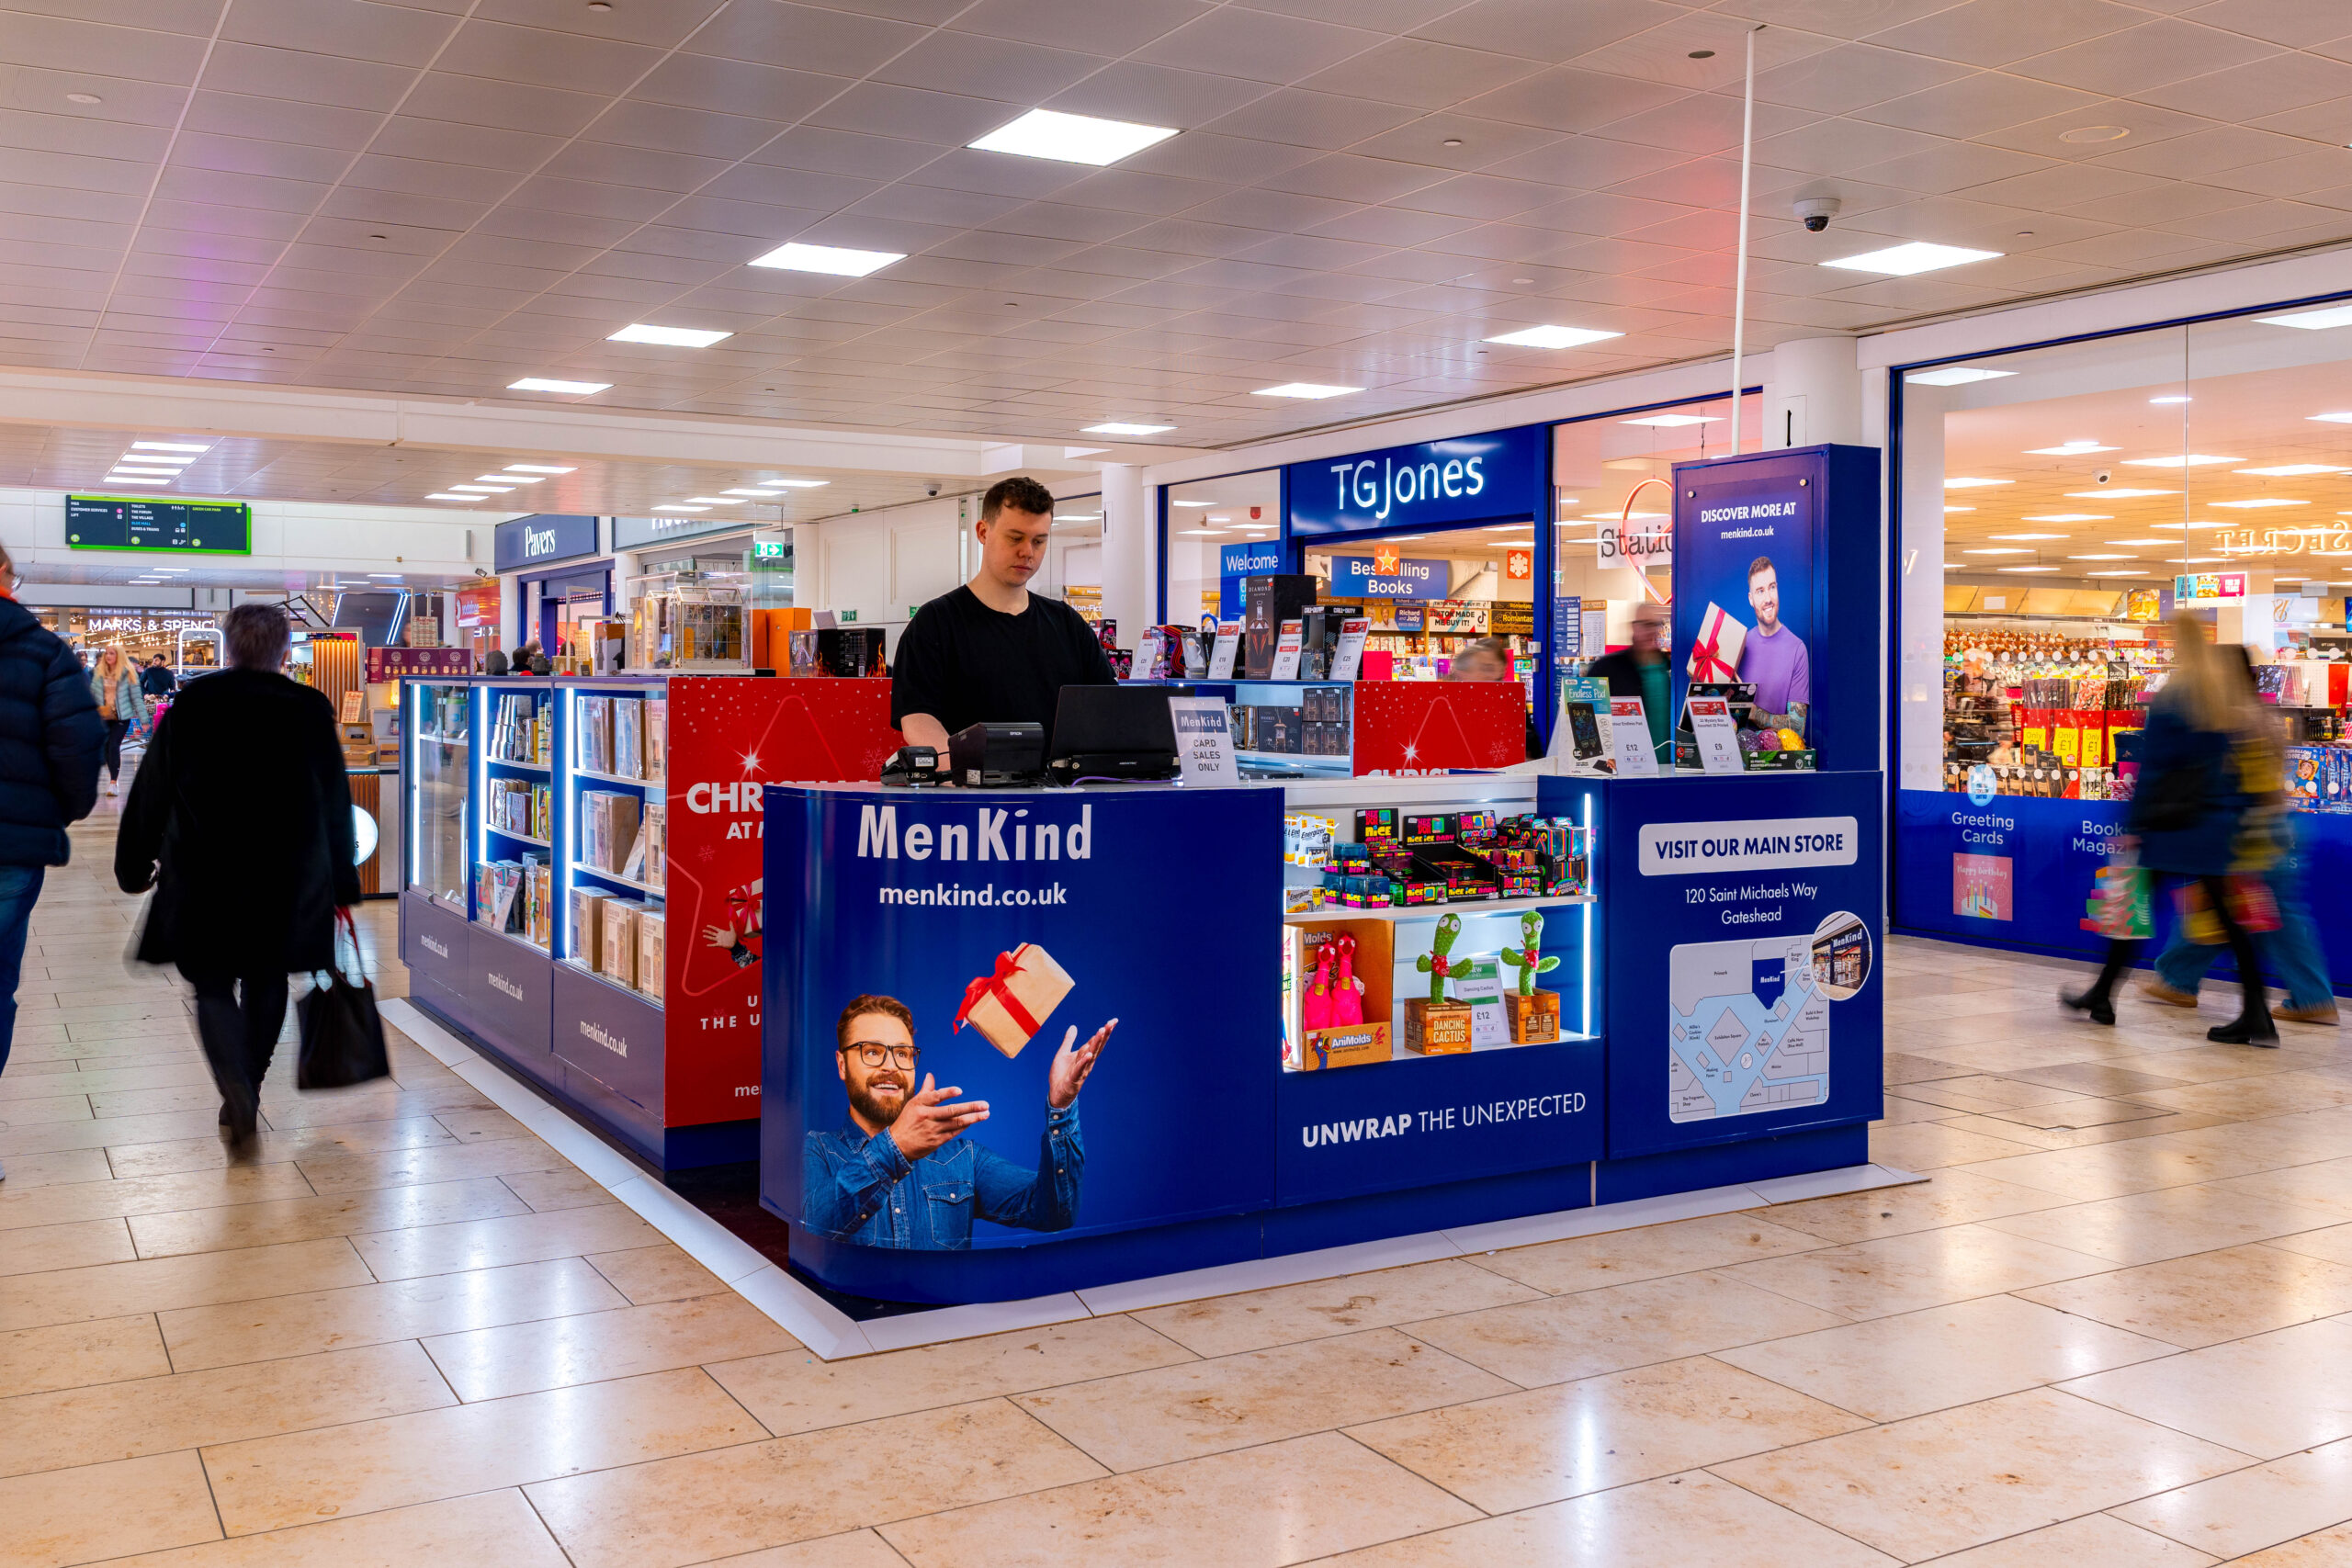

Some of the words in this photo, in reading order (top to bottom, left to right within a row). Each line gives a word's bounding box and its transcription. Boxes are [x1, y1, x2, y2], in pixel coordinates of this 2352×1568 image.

[1701, 506, 1750, 523] DISCOVER
[1751, 503, 1781, 518] MORE
[1782, 502, 1796, 515] AT
[1721, 525, 1774, 540] menkind.co.uk
[525, 525, 556, 558] Pavers
[1227, 554, 1279, 572] Welcome
[1368, 580, 1413, 594] Books
[88, 618, 141, 631] MARKS
[148, 619, 158, 631] &
[164, 619, 215, 630] SPENC
[1568, 688, 1592, 699] Endless
[1593, 688, 1606, 698] Pad
[1181, 713, 1223, 729] MenKind
[2057, 731, 2075, 741] Only
[2086, 732, 2100, 742] Only
[1193, 739, 1216, 749] CARD
[2059, 739, 2073, 751] £1
[2087, 741, 2098, 752] £1
[1193, 750, 1221, 761] SALES
[1198, 761, 1220, 773] ONLY
[1951, 811, 2015, 831] Greeting
[2082, 820, 2123, 837] Book
[726, 822, 753, 840] AT
[856, 803, 1092, 863] MenKind
[1300, 828, 1326, 840] Energizer
[1461, 829, 1498, 840] gumdrop
[1962, 829, 2004, 845] Cards
[1655, 840, 1699, 860] VISIT
[1702, 838, 1740, 857] OUR
[1744, 836, 1790, 855] MAIN
[1794, 833, 1843, 853] STORE
[2073, 838, 2125, 856] Magaz
[1349, 859, 1363, 867] NiC
[1957, 864, 1976, 876] Happy
[1977, 866, 2007, 879] Birthday
[879, 882, 1068, 907] menkind.co.uk
[1289, 889, 1310, 901] Energizer
[1502, 888, 1532, 897] gumdrop
[1685, 888, 1706, 904] 120
[1709, 886, 1737, 903] Saint
[1740, 882, 1790, 901] Michaels
[1792, 882, 1818, 899] Way
[1721, 906, 1782, 925] Gateshead
[1304, 931, 1332, 945] Molds
[1833, 928, 1863, 948] MenKind
[421, 933, 449, 959] menkind.co.uk
[488, 971, 524, 1001] menkind.co.uk
[1759, 975, 1781, 984] MenKind
[700, 1014, 738, 1031] THE
[1476, 1011, 1490, 1021] £12
[1433, 1019, 1465, 1032] DANCING
[580, 1020, 628, 1058] menkind.co.uk
[1331, 1033, 1372, 1048] AniMolds
[1433, 1030, 1465, 1043] CACTUS
[1302, 1113, 1412, 1148] UNWRAP
[1418, 1108, 1455, 1133] THE
[1463, 1091, 1586, 1127] UNEXPECTED
